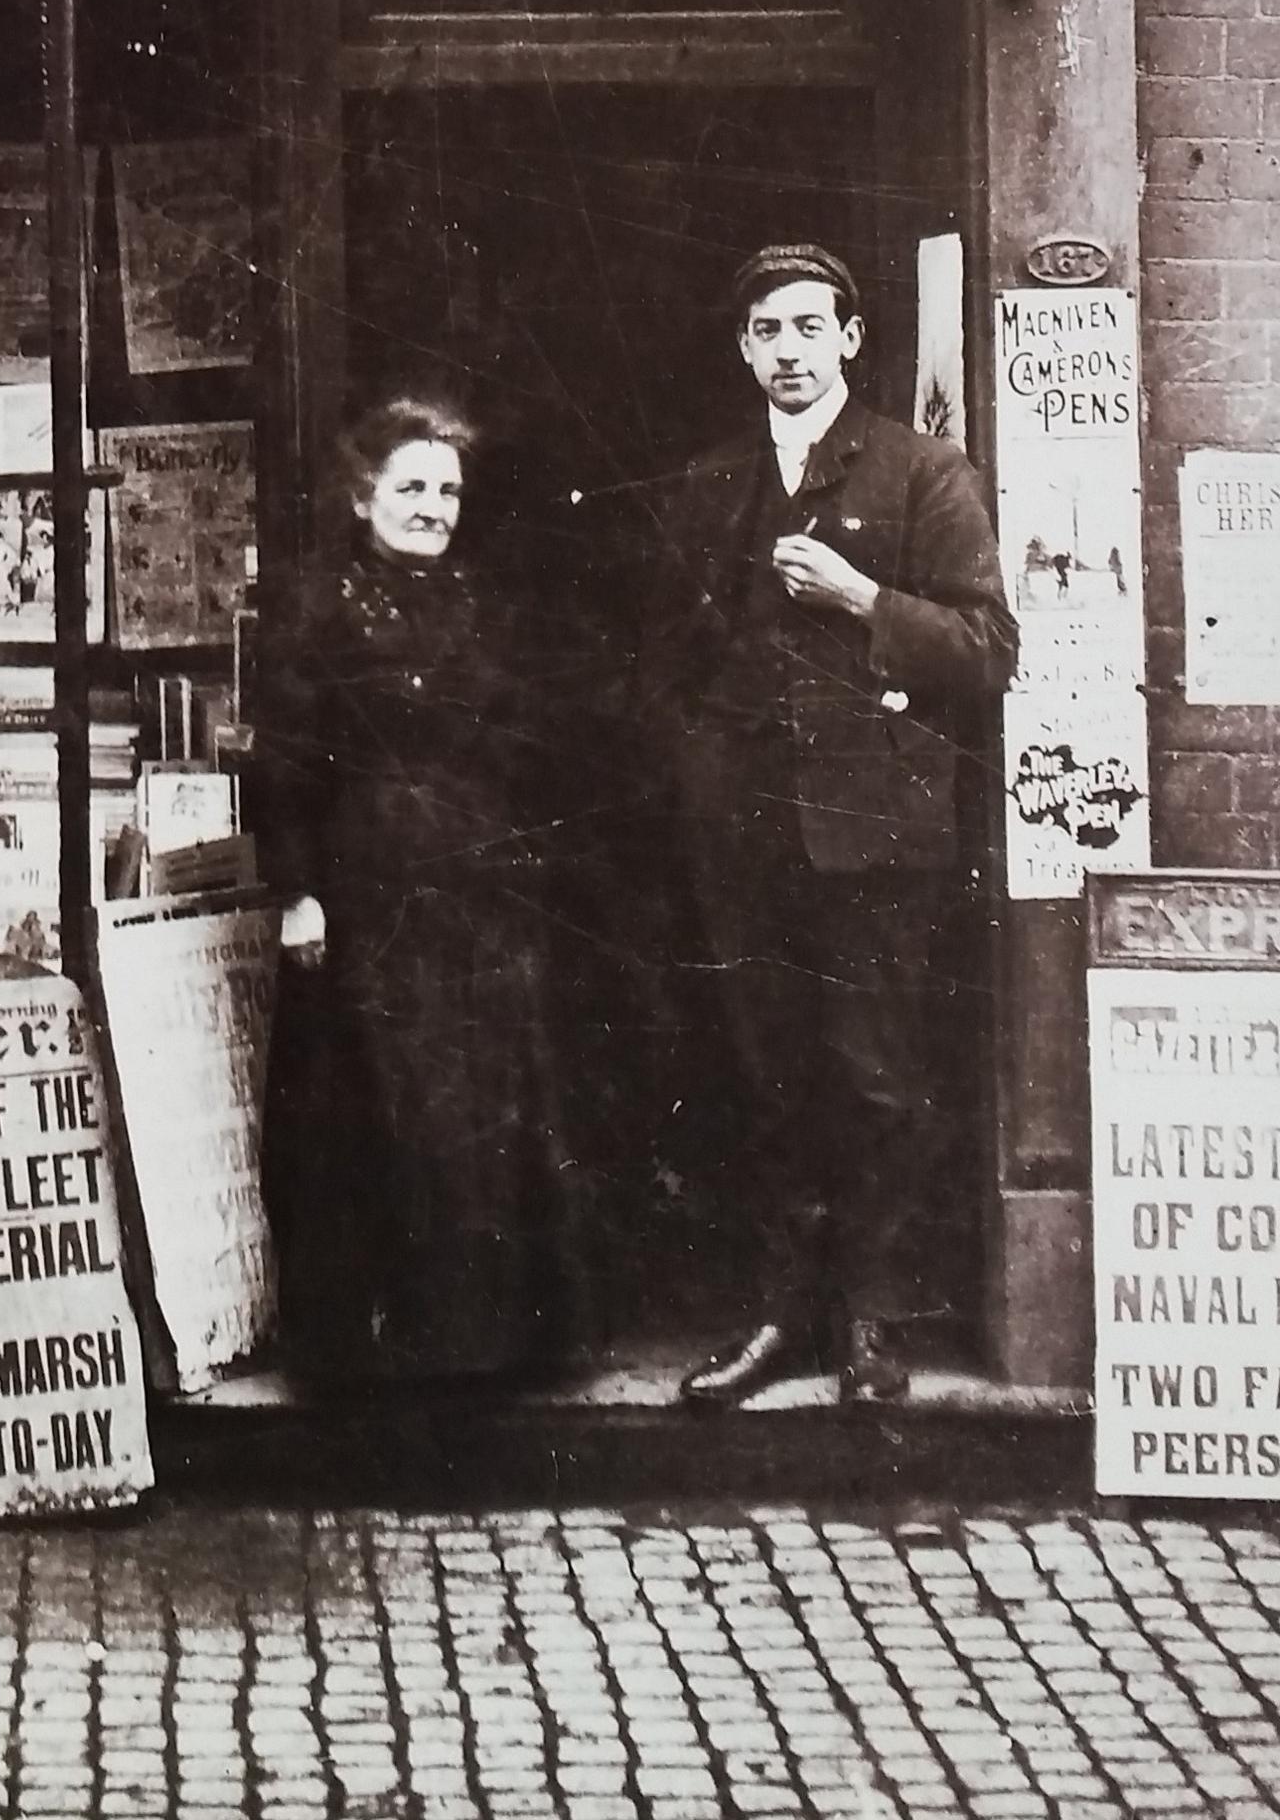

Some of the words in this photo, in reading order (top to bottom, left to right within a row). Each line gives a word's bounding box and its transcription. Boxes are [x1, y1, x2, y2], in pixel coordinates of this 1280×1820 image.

[1002, 301, 1118, 357] MACNIVEN
[1032, 388, 1130, 432] PENS
[30, 1073, 100, 1134] THE
[1133, 1202, 1194, 1251] OF
[1113, 1274, 1258, 1325] NAVAL
[1111, 1363, 1218, 1408] TWO
[1243, 1365, 1280, 1410] F
[1132, 1430, 1280, 1478] PEERS
